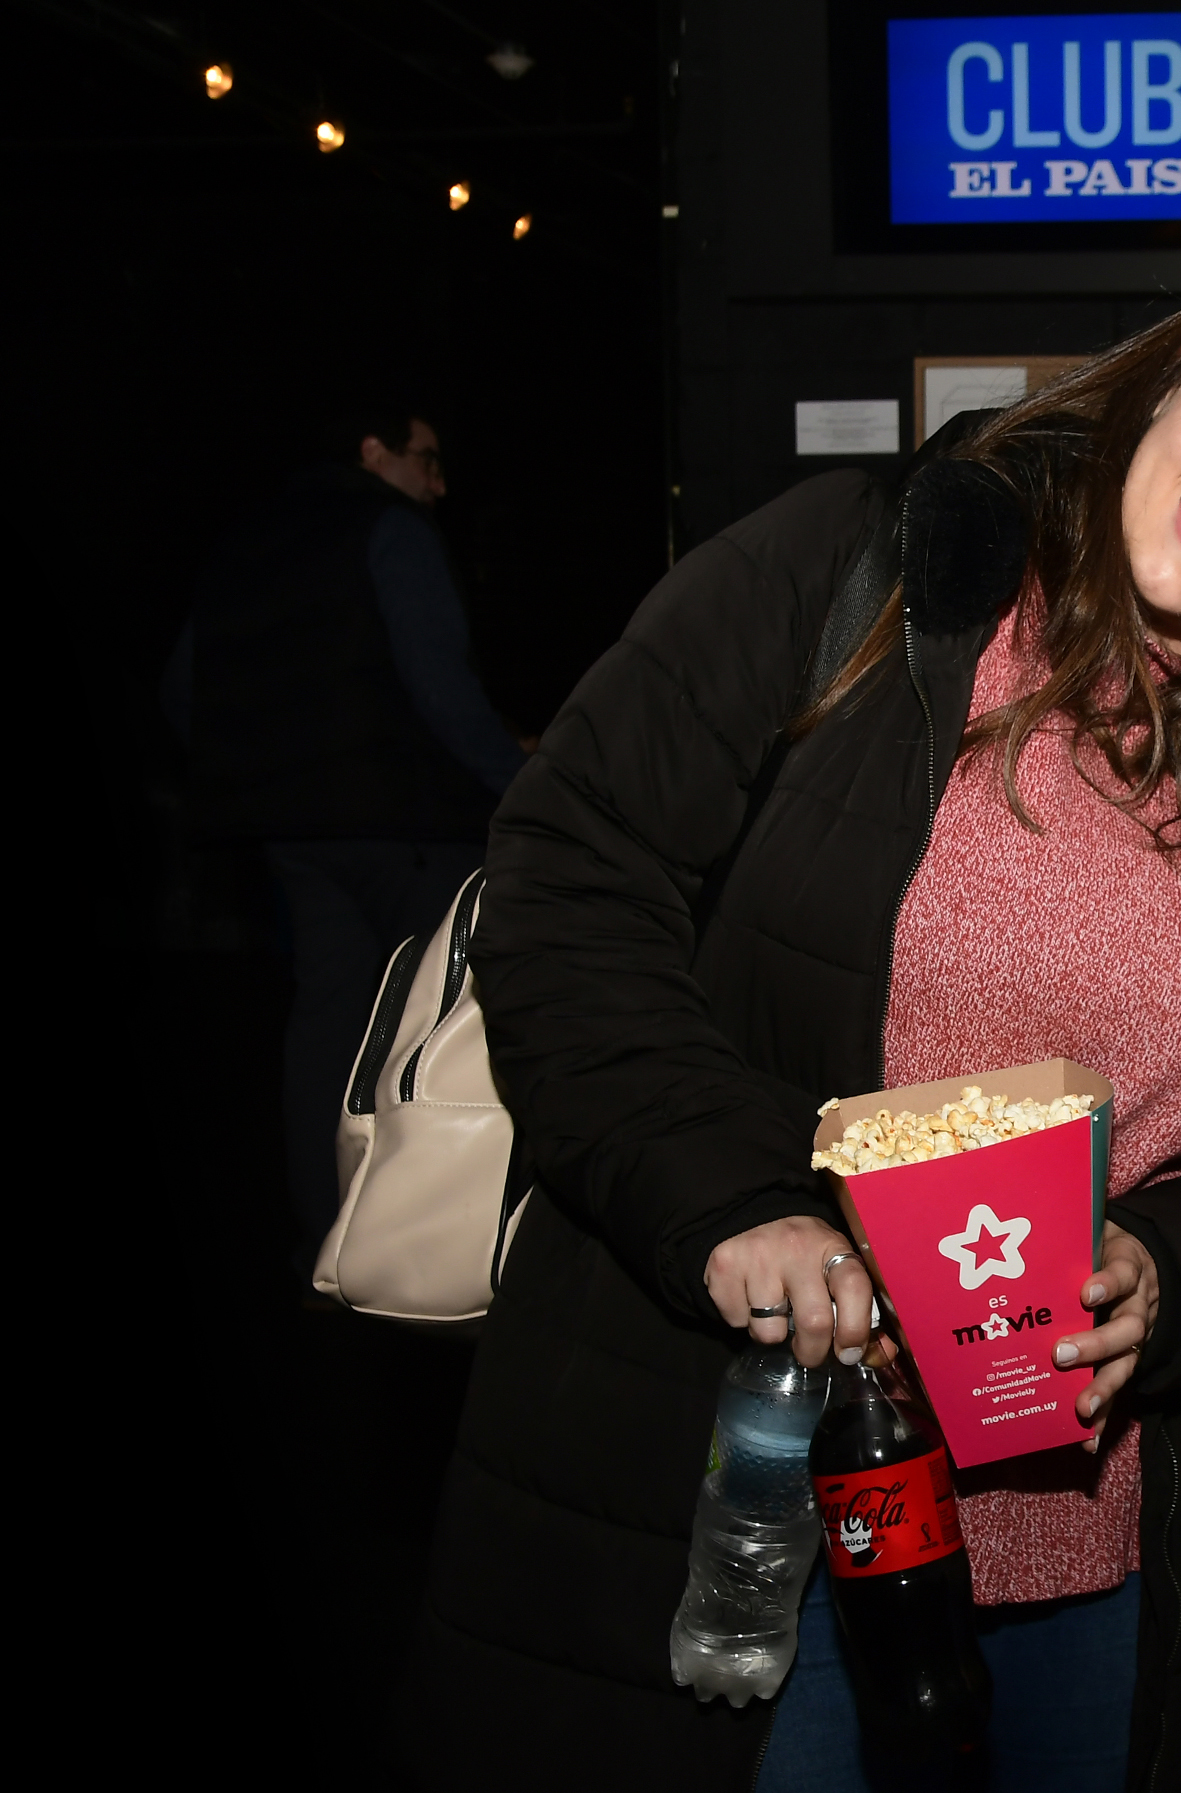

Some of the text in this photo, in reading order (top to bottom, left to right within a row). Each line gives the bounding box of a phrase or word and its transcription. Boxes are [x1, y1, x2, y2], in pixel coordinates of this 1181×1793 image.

[949, 161, 1031, 198] EL
[989, 1294, 1008, 1309] es
[991, 1356, 1018, 1367] Seguinos
[981, 1401, 1057, 1426] movie.com.uy
